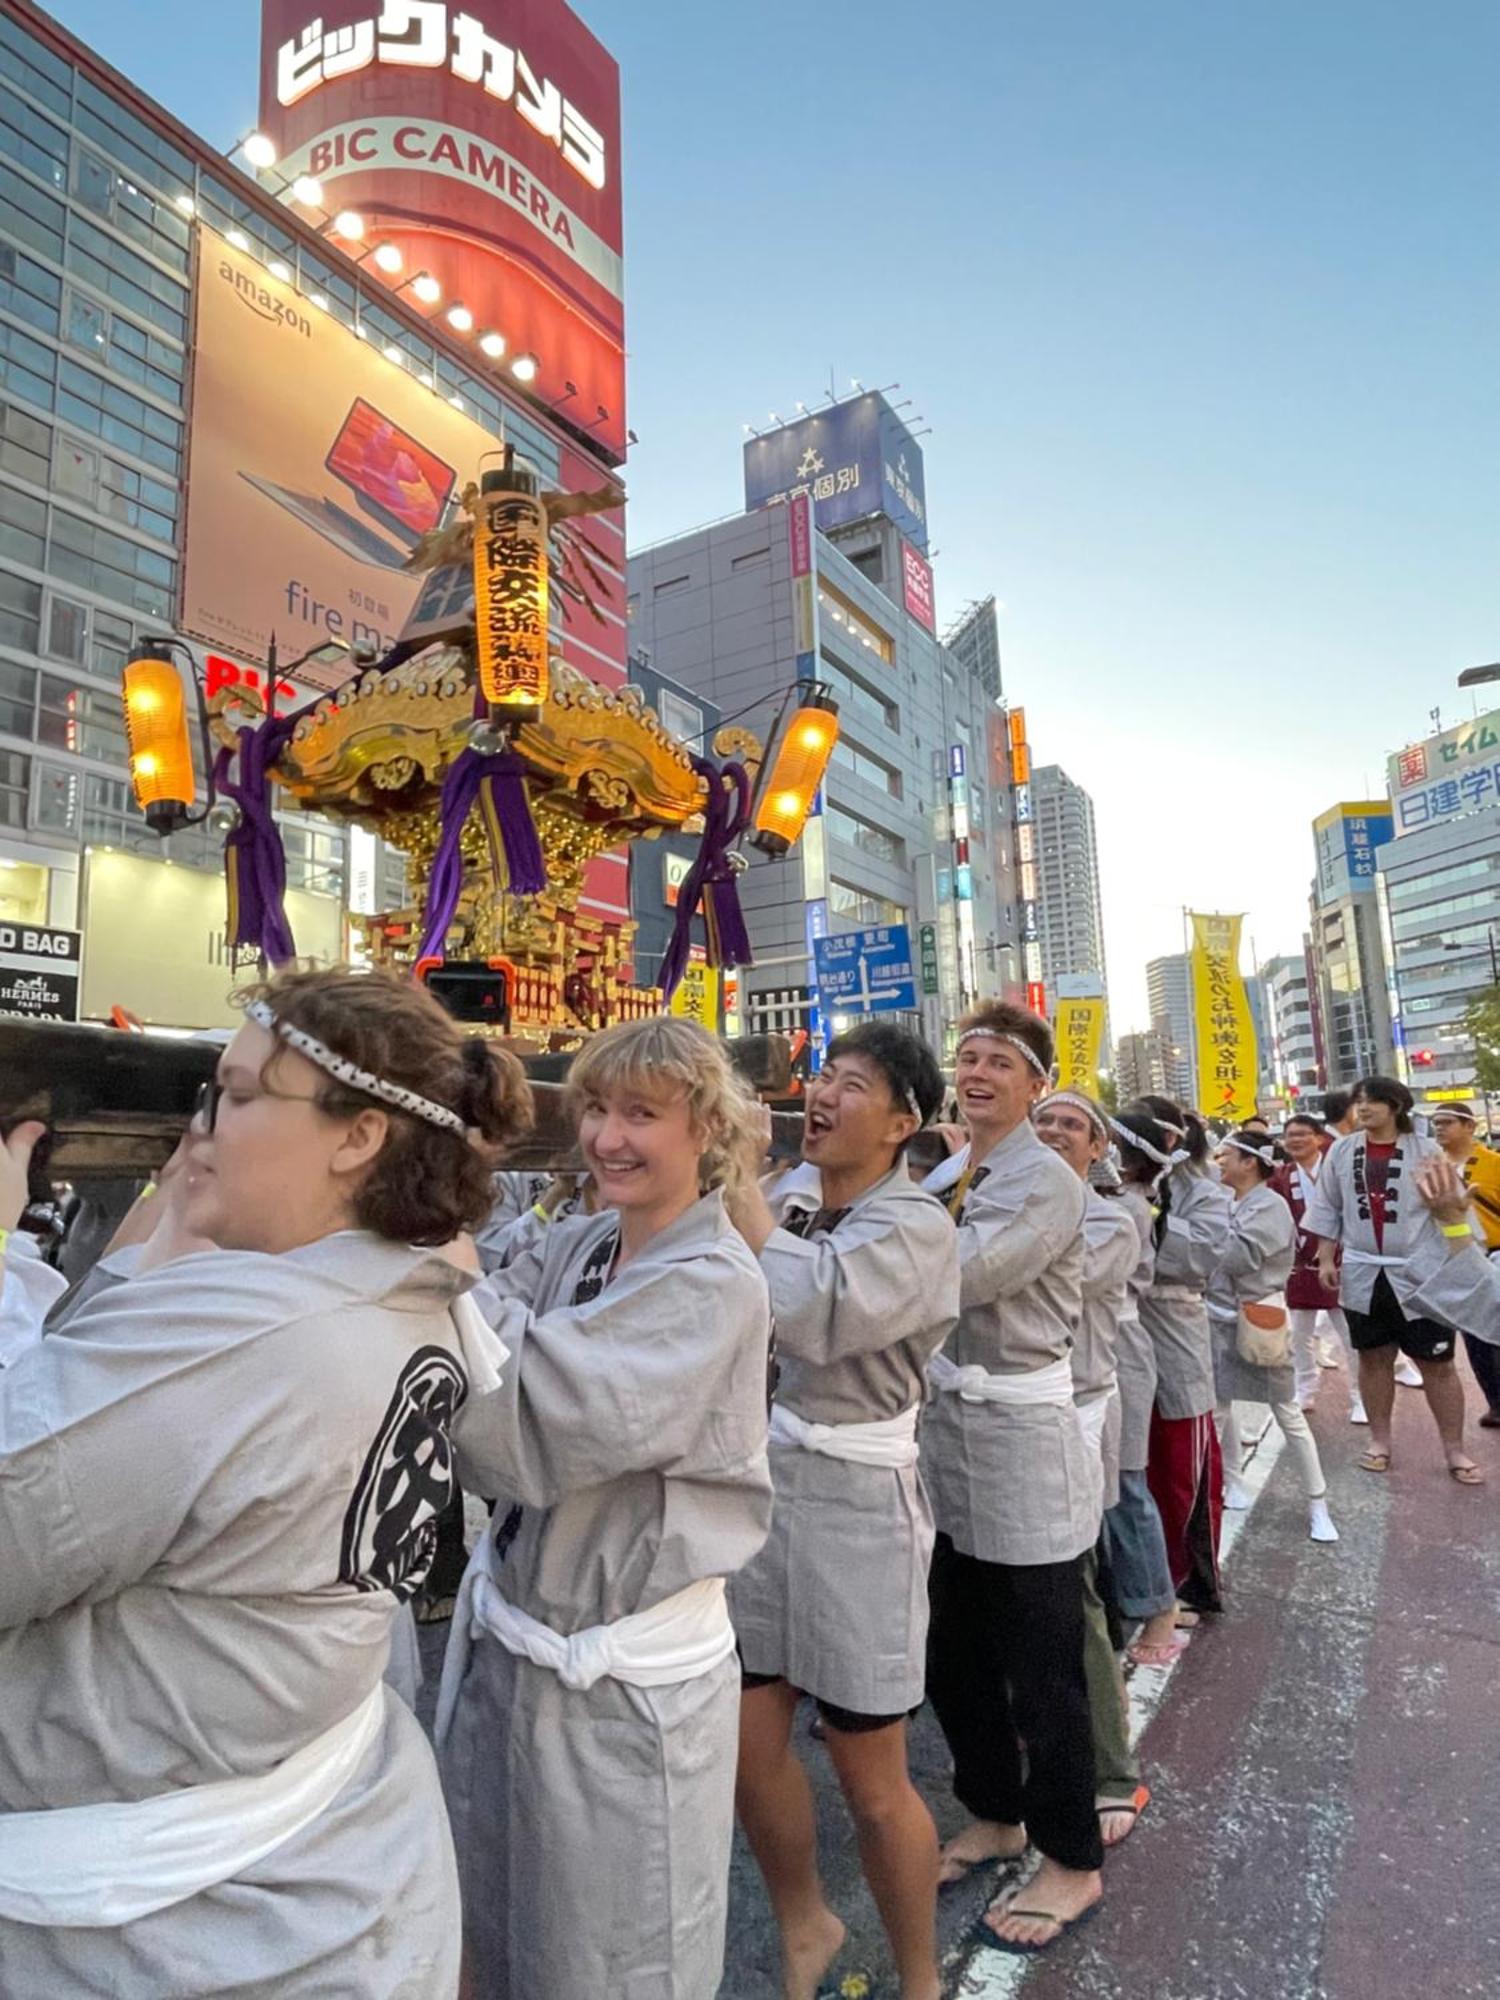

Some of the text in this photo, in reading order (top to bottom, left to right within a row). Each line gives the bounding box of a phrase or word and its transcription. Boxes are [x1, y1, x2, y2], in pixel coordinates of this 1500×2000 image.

[277, 0, 605, 190] ビックカメラ
[309, 127, 575, 251] BIC CAMERA
[218, 260, 313, 338] amazon
[285, 580, 343, 635] fire
[22, 931, 70, 955] BAG
[1, 987, 60, 1004] HERMES
